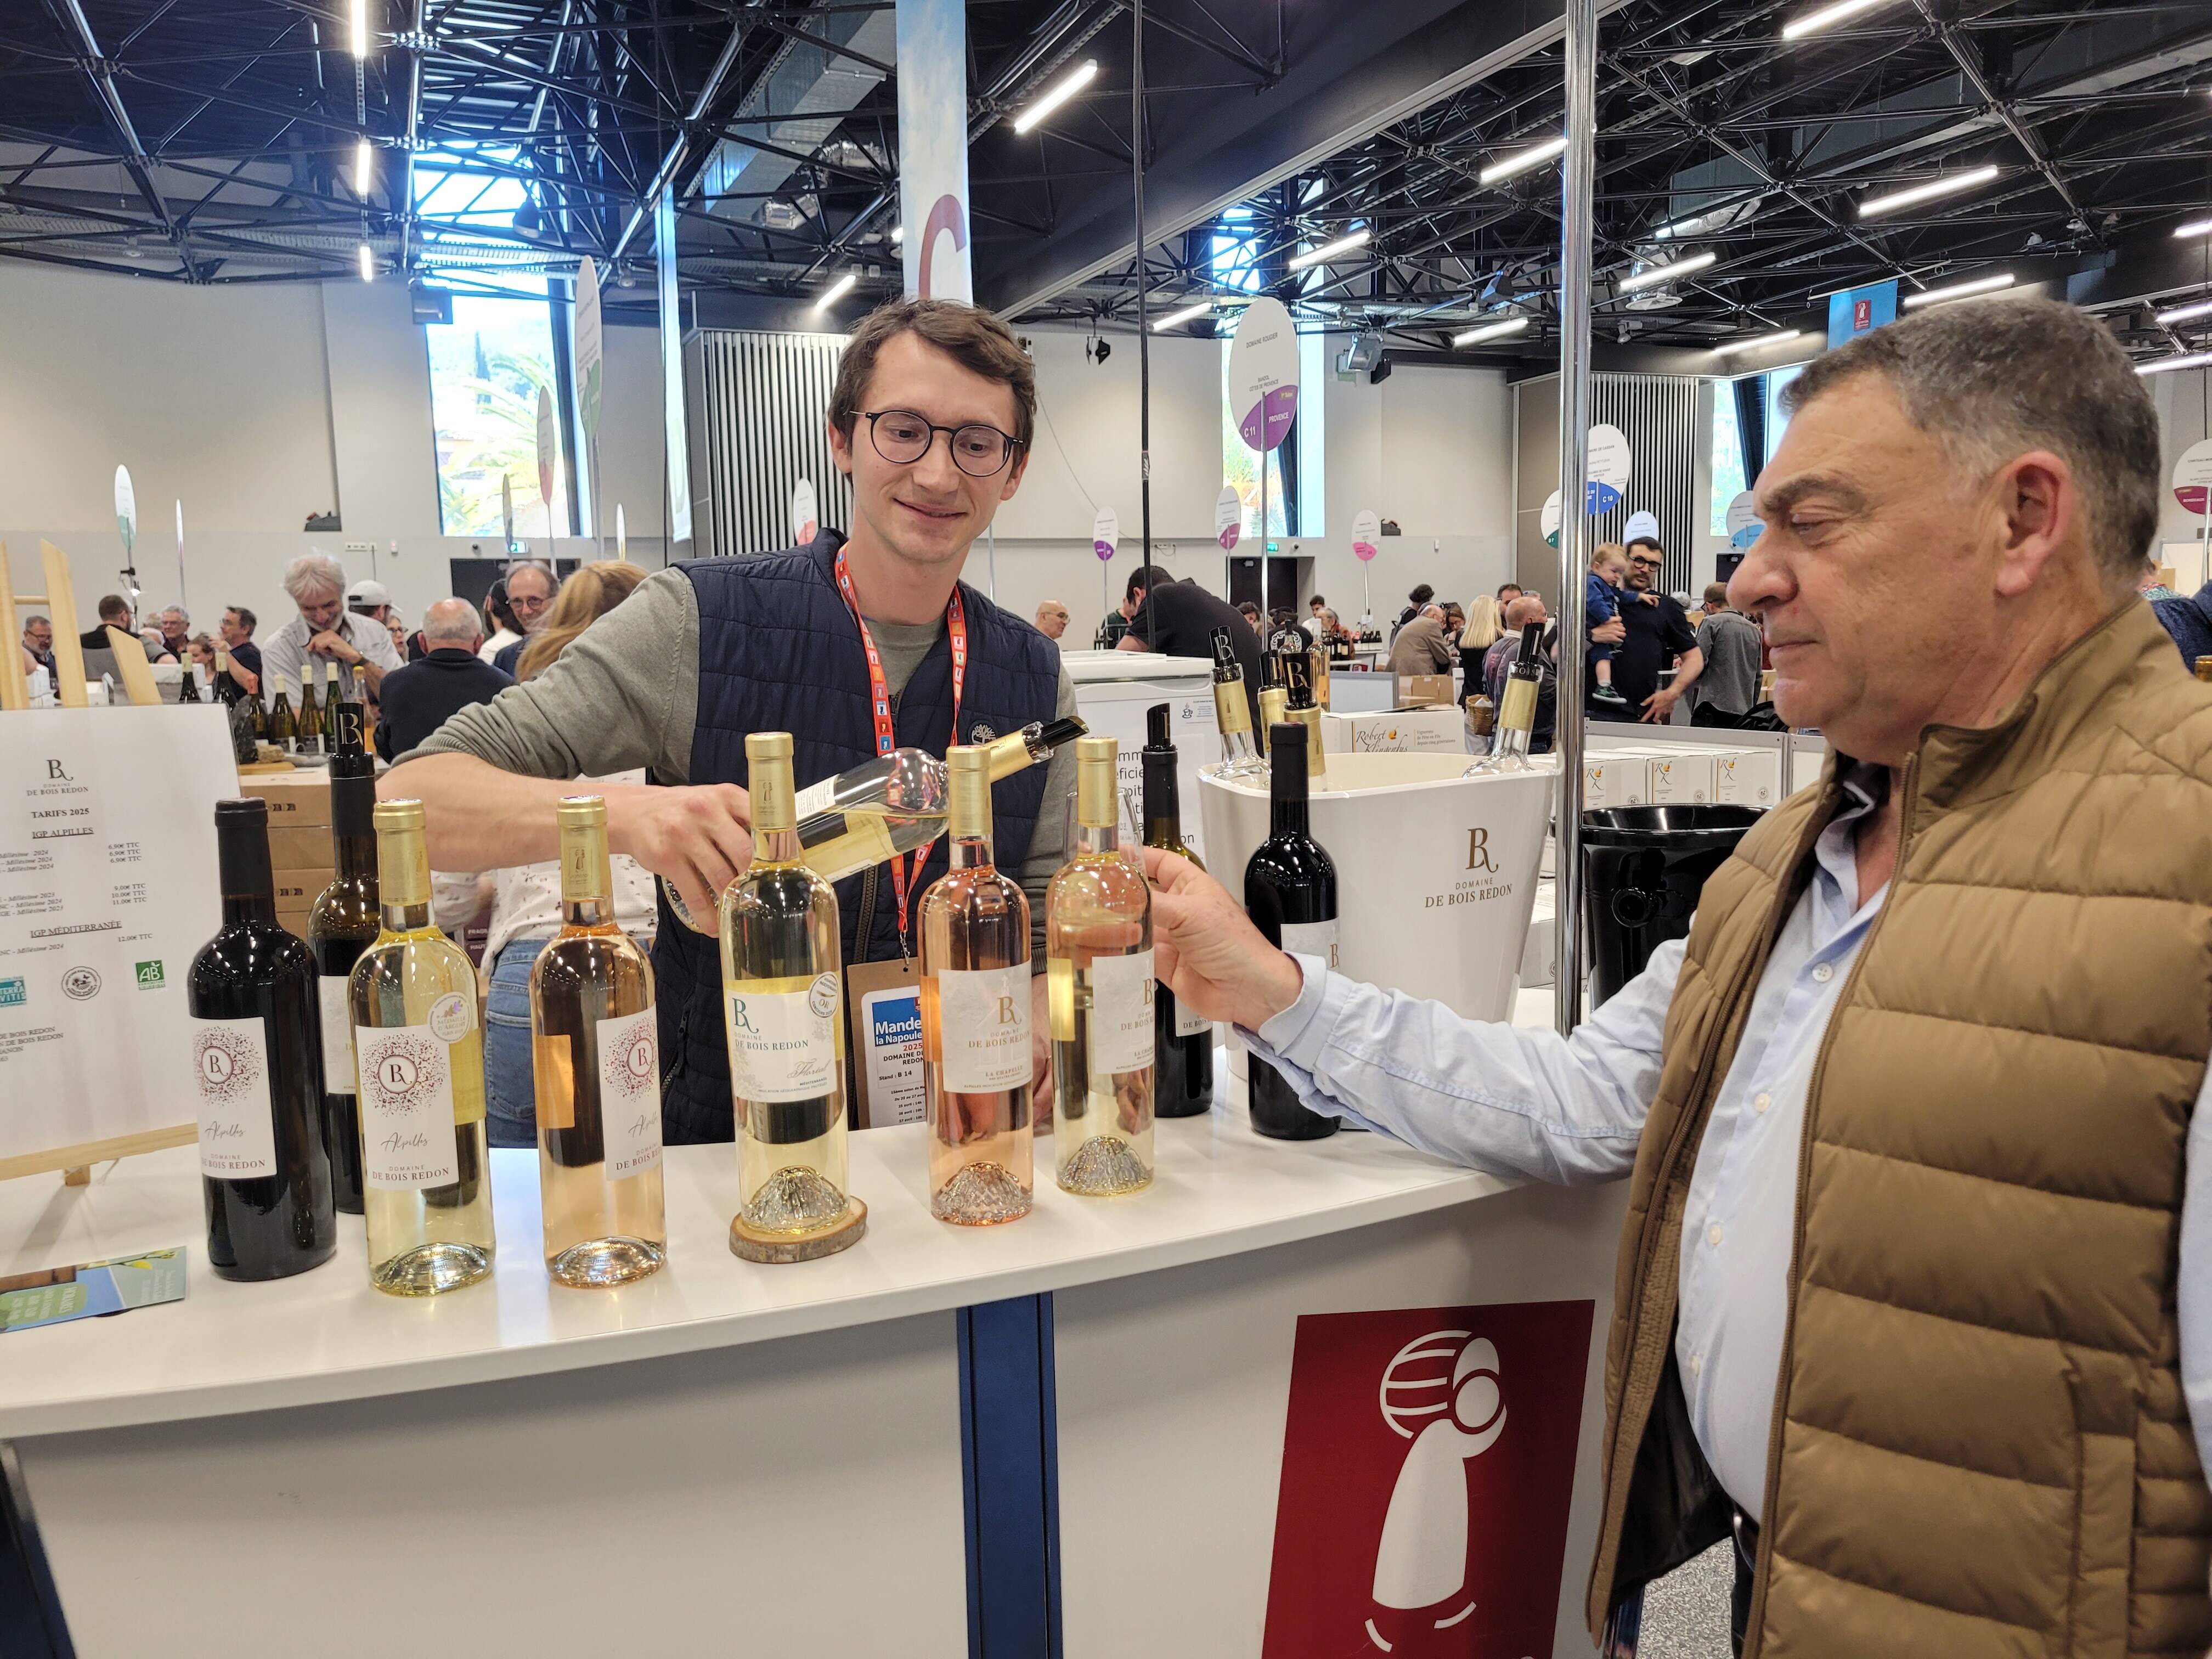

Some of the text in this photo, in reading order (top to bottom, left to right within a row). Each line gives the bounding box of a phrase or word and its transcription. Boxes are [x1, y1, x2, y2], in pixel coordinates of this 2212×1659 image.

[1268, 411, 1290, 424] PROVENCE
[1244, 426, 1256, 438] C 11
[1356, 723, 1386, 746] Robert
[31, 810, 67, 819] TARIFS
[50, 827, 94, 836] ALPILLES
[1455, 877, 1493, 890] DOMAINE
[1425, 883, 1513, 908] DE BOIS REDON
[31, 920, 122, 938] IGP MÉDITERRANÉE
[139, 966, 160, 982] AB
[819, 998, 830, 1010] OR
[876, 1017, 922, 1035] Mande
[1121, 1017, 1149, 1031] DE BOIS
[29, 1026, 55, 1036] REDON
[734, 1031, 762, 1041] DOMAINE
[990, 1028, 1019, 1037] DOMAINE
[37, 1033, 64, 1042] REDON
[876, 1031, 922, 1045] la Napoule
[986, 1037, 1007, 1048] BOIS
[735, 1040, 809, 1051] DE BOIS REDON
[903, 1042, 922, 1051] 2025
[883, 1052, 915, 1062] DOMAINE
[996, 1065, 1023, 1076] CHAPELLE
[205, 1121, 247, 1141] Alpilles
[381, 1132, 430, 1153] Alpilles
[208, 1160, 227, 1169] BOIS
[229, 1159, 266, 1169] REDON
[616, 1153, 650, 1170] DE BOIS
[373, 1167, 449, 1181] DE BOIS REDON
